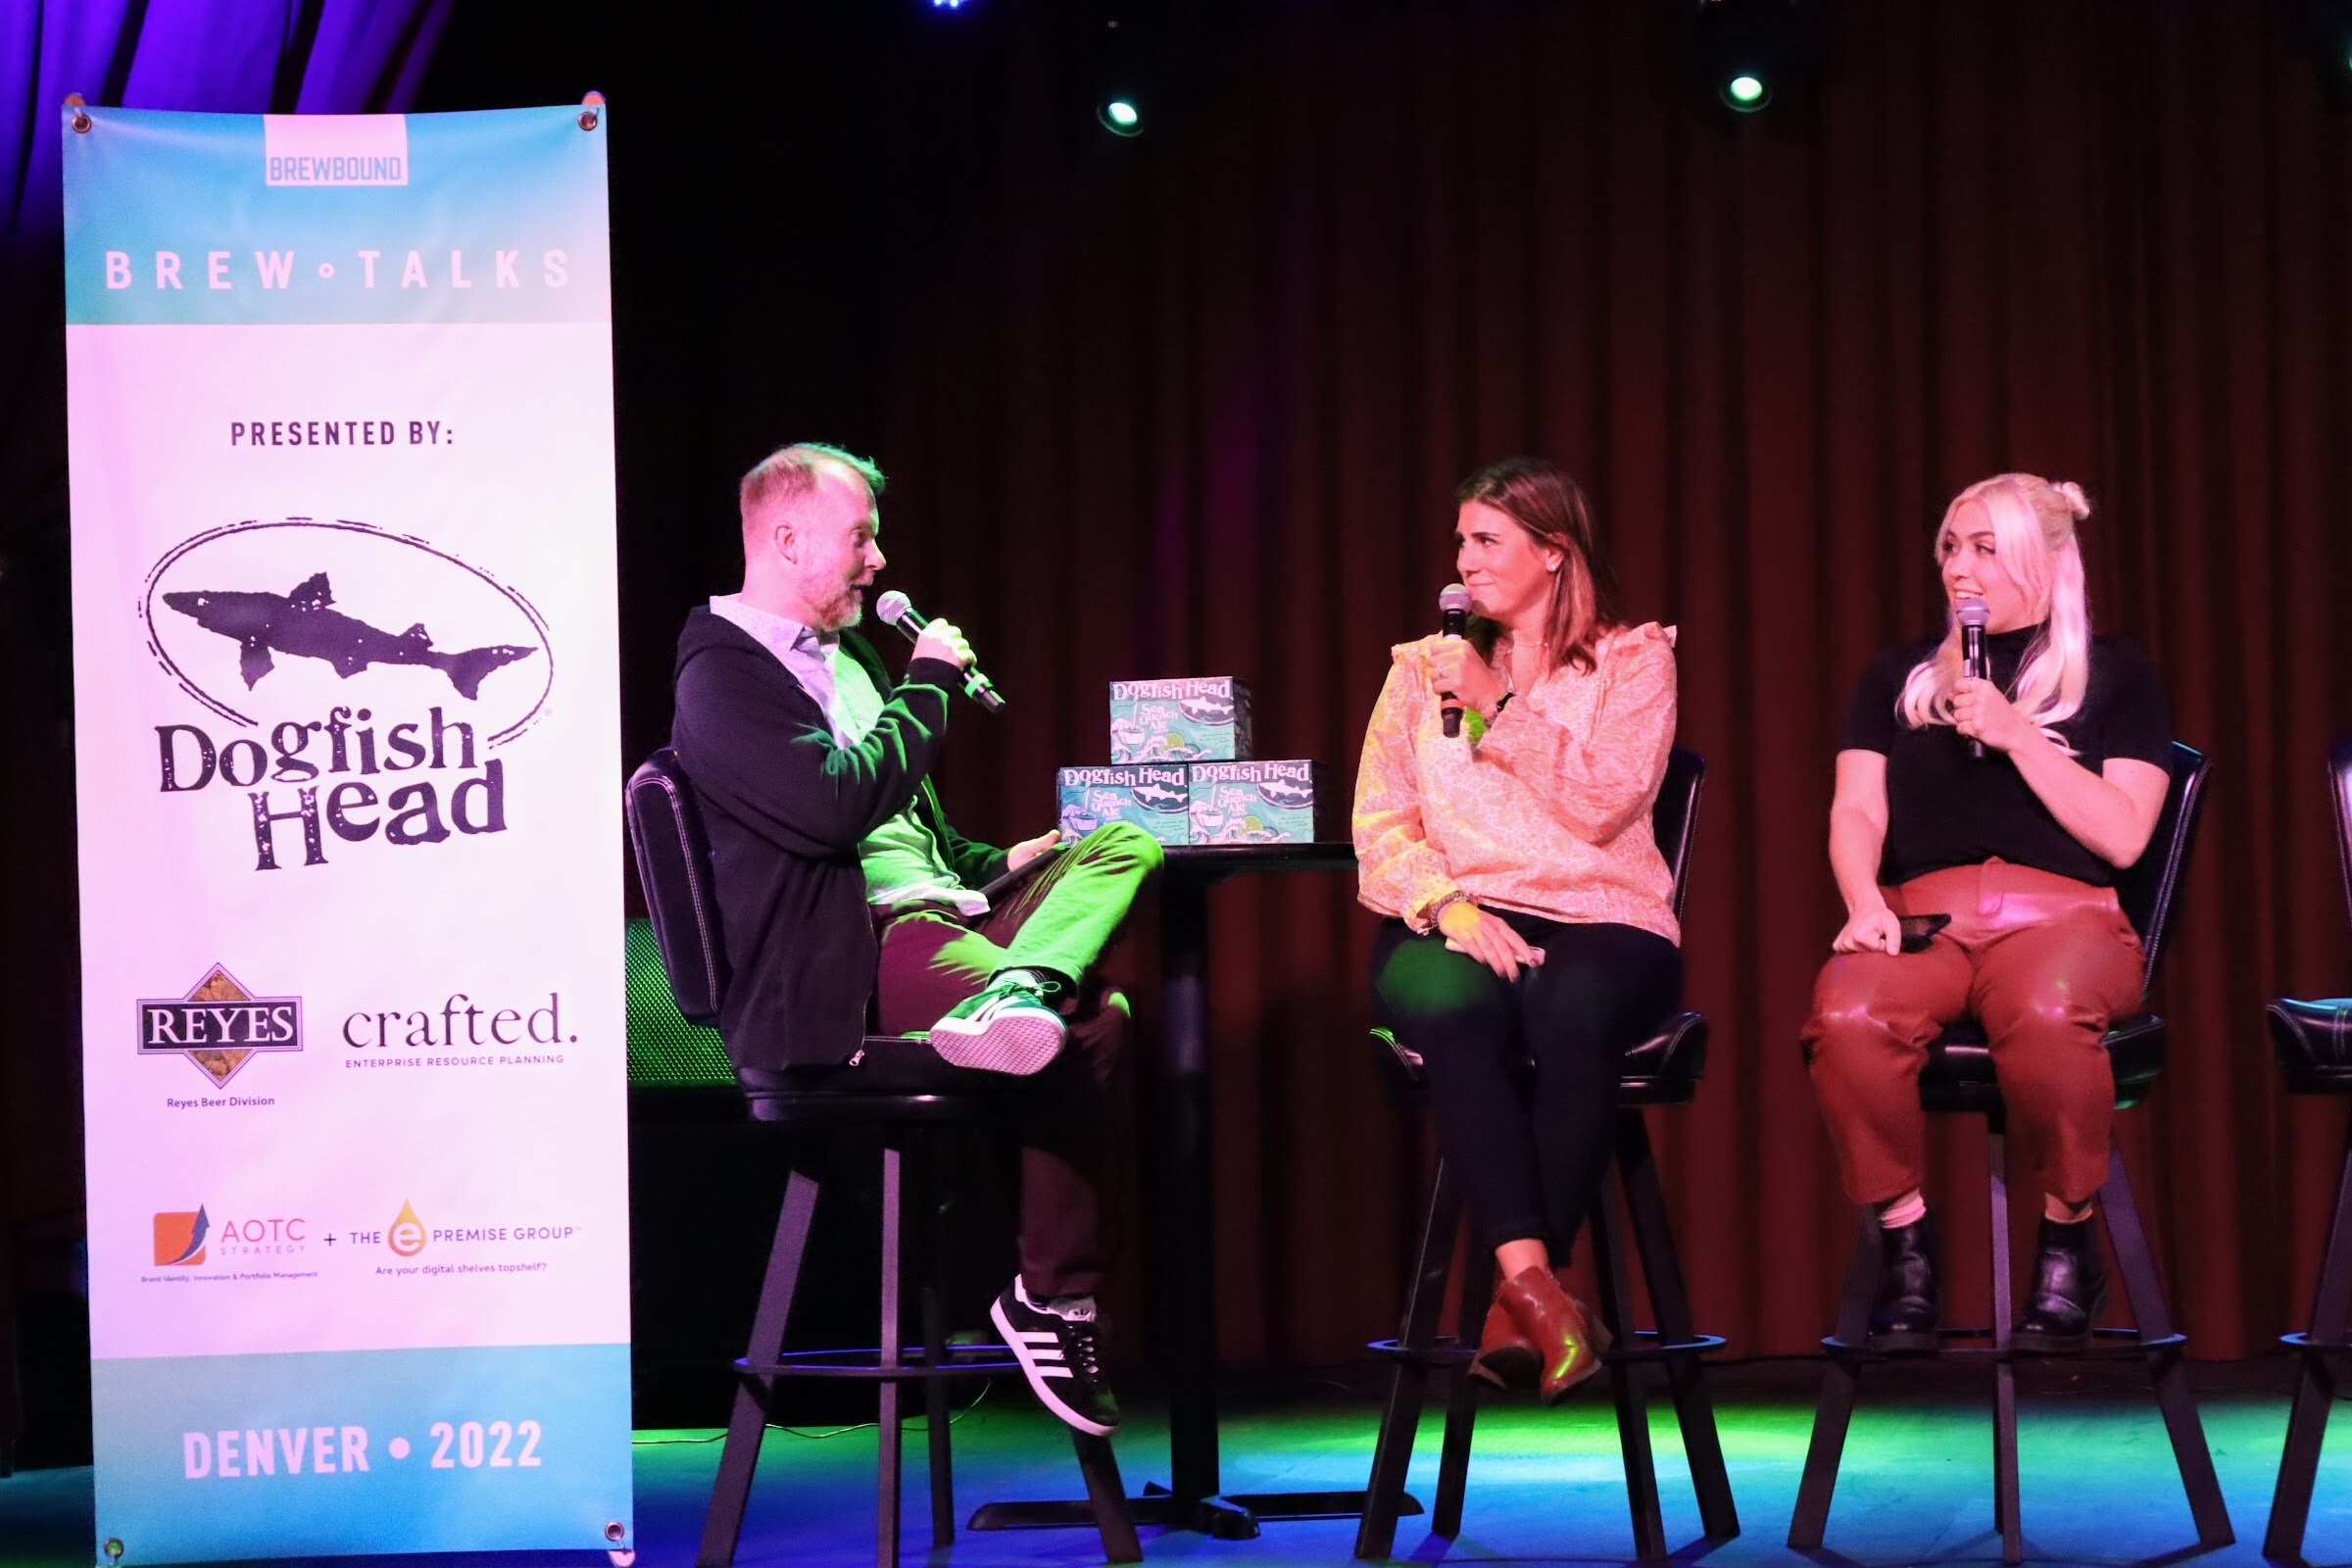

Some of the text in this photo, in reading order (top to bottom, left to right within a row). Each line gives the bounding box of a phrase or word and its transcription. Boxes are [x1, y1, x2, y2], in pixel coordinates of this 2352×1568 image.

[270, 157, 402, 181] BREWBOUND
[105, 249, 568, 290] BREW TALKS
[231, 421, 454, 446] PRESENTED BY:
[1113, 679, 1231, 701] Dogfish Head
[1141, 704, 1165, 715] Sea
[1140, 710, 1178, 725] Quench
[1150, 720, 1168, 730] Ale
[154, 706, 478, 792] Dogfish
[1063, 767, 1185, 786] Dogfish Head
[1192, 762, 1309, 782] Dogfish Head
[1094, 790, 1117, 801] Sea
[1220, 786, 1244, 796] Sea
[1092, 798, 1131, 811] Quench
[1218, 793, 1257, 808] Quench
[1228, 803, 1247, 813] Ale
[248, 759, 507, 871] Head
[1102, 808, 1120, 817] Ale
[147, 1006, 293, 1044] REYES
[343, 992, 577, 1049] crafted.
[346, 1054, 564, 1068] ENTERPRISE RESOURCE PLANNING
[167, 1097, 274, 1109] Reyes Beer Division
[220, 1218, 306, 1243] AOTC
[350, 1232, 381, 1245] THE
[433, 1228, 507, 1242] PREMISE
[220, 1246, 306, 1255] STRATEGY
[273, 1271, 318, 1280] Management
[375, 1262, 547, 1277] Are your digital shelves topshelf?
[183, 1420, 542, 1479] DENVER 2022
